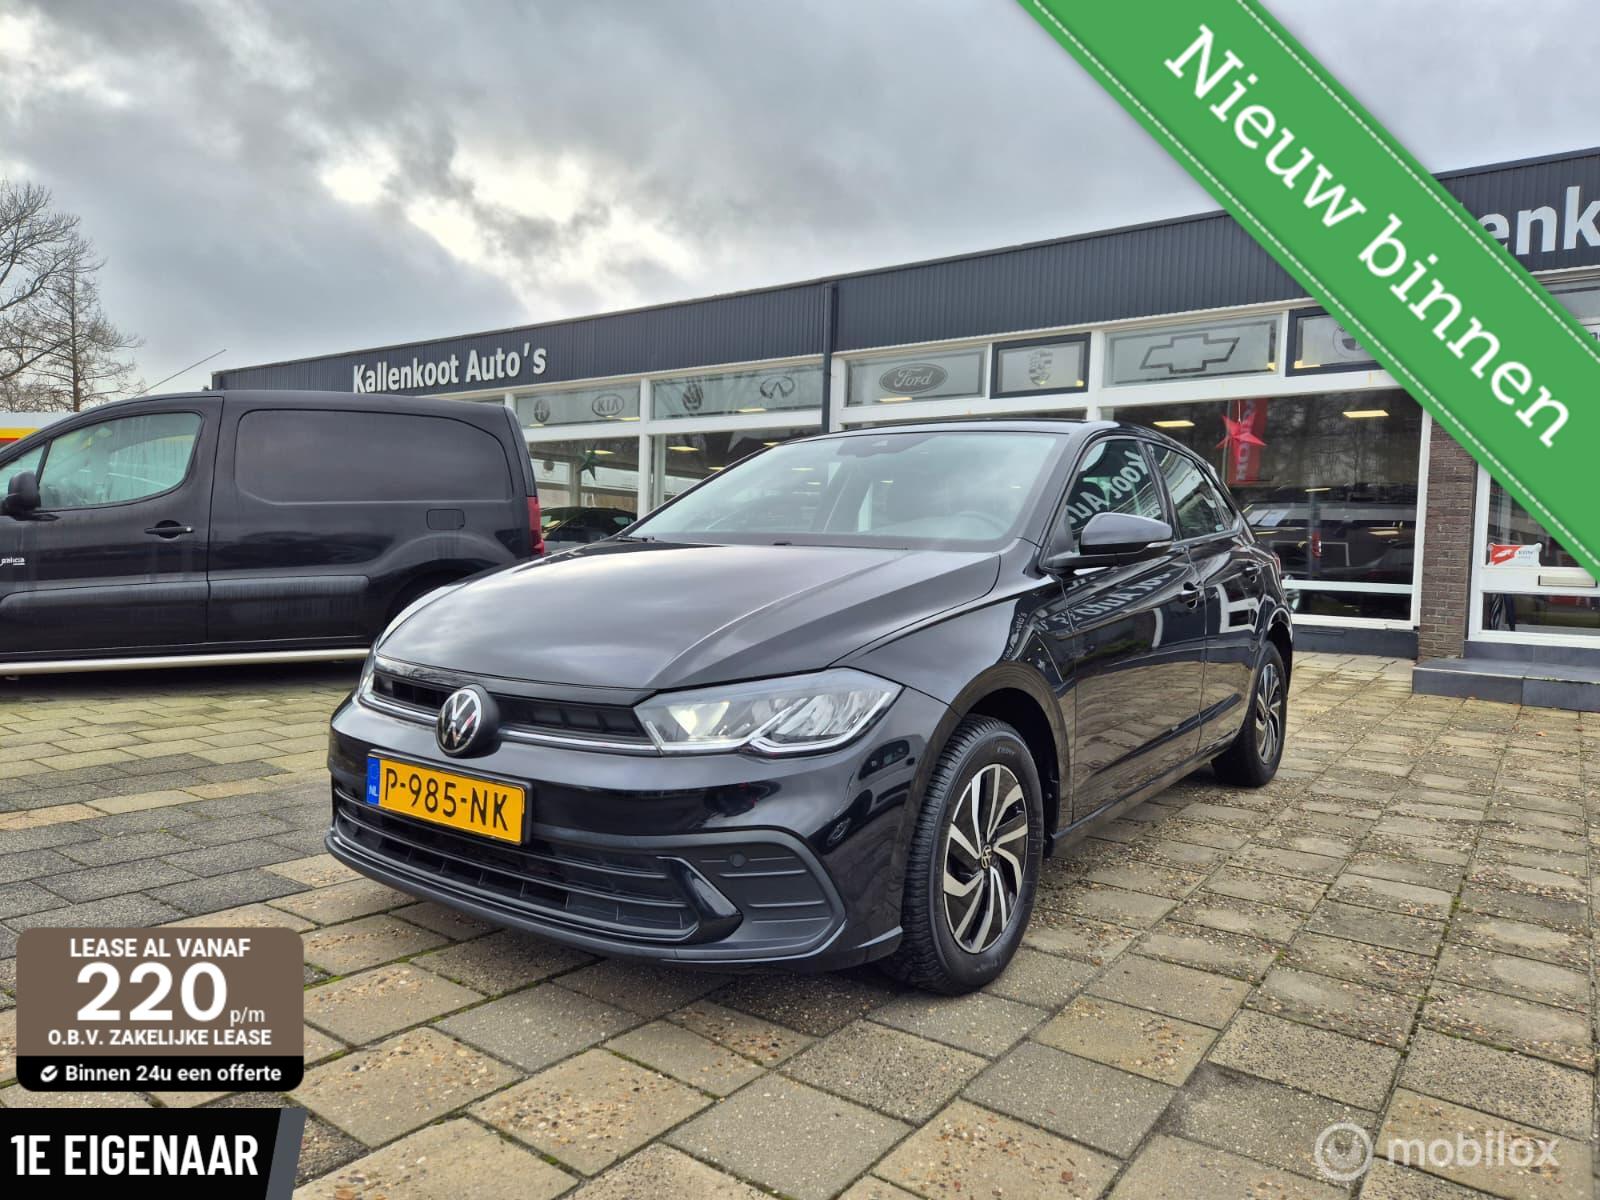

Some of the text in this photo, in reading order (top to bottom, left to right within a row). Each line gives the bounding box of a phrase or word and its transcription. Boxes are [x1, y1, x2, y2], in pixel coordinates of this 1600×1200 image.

[1458, 186, 1600, 255] enk
[353, 342, 547, 394] Kallenkoot Auto's
[893, 367, 932, 388] Ford
[385, 767, 508, 831] P-985-NK
